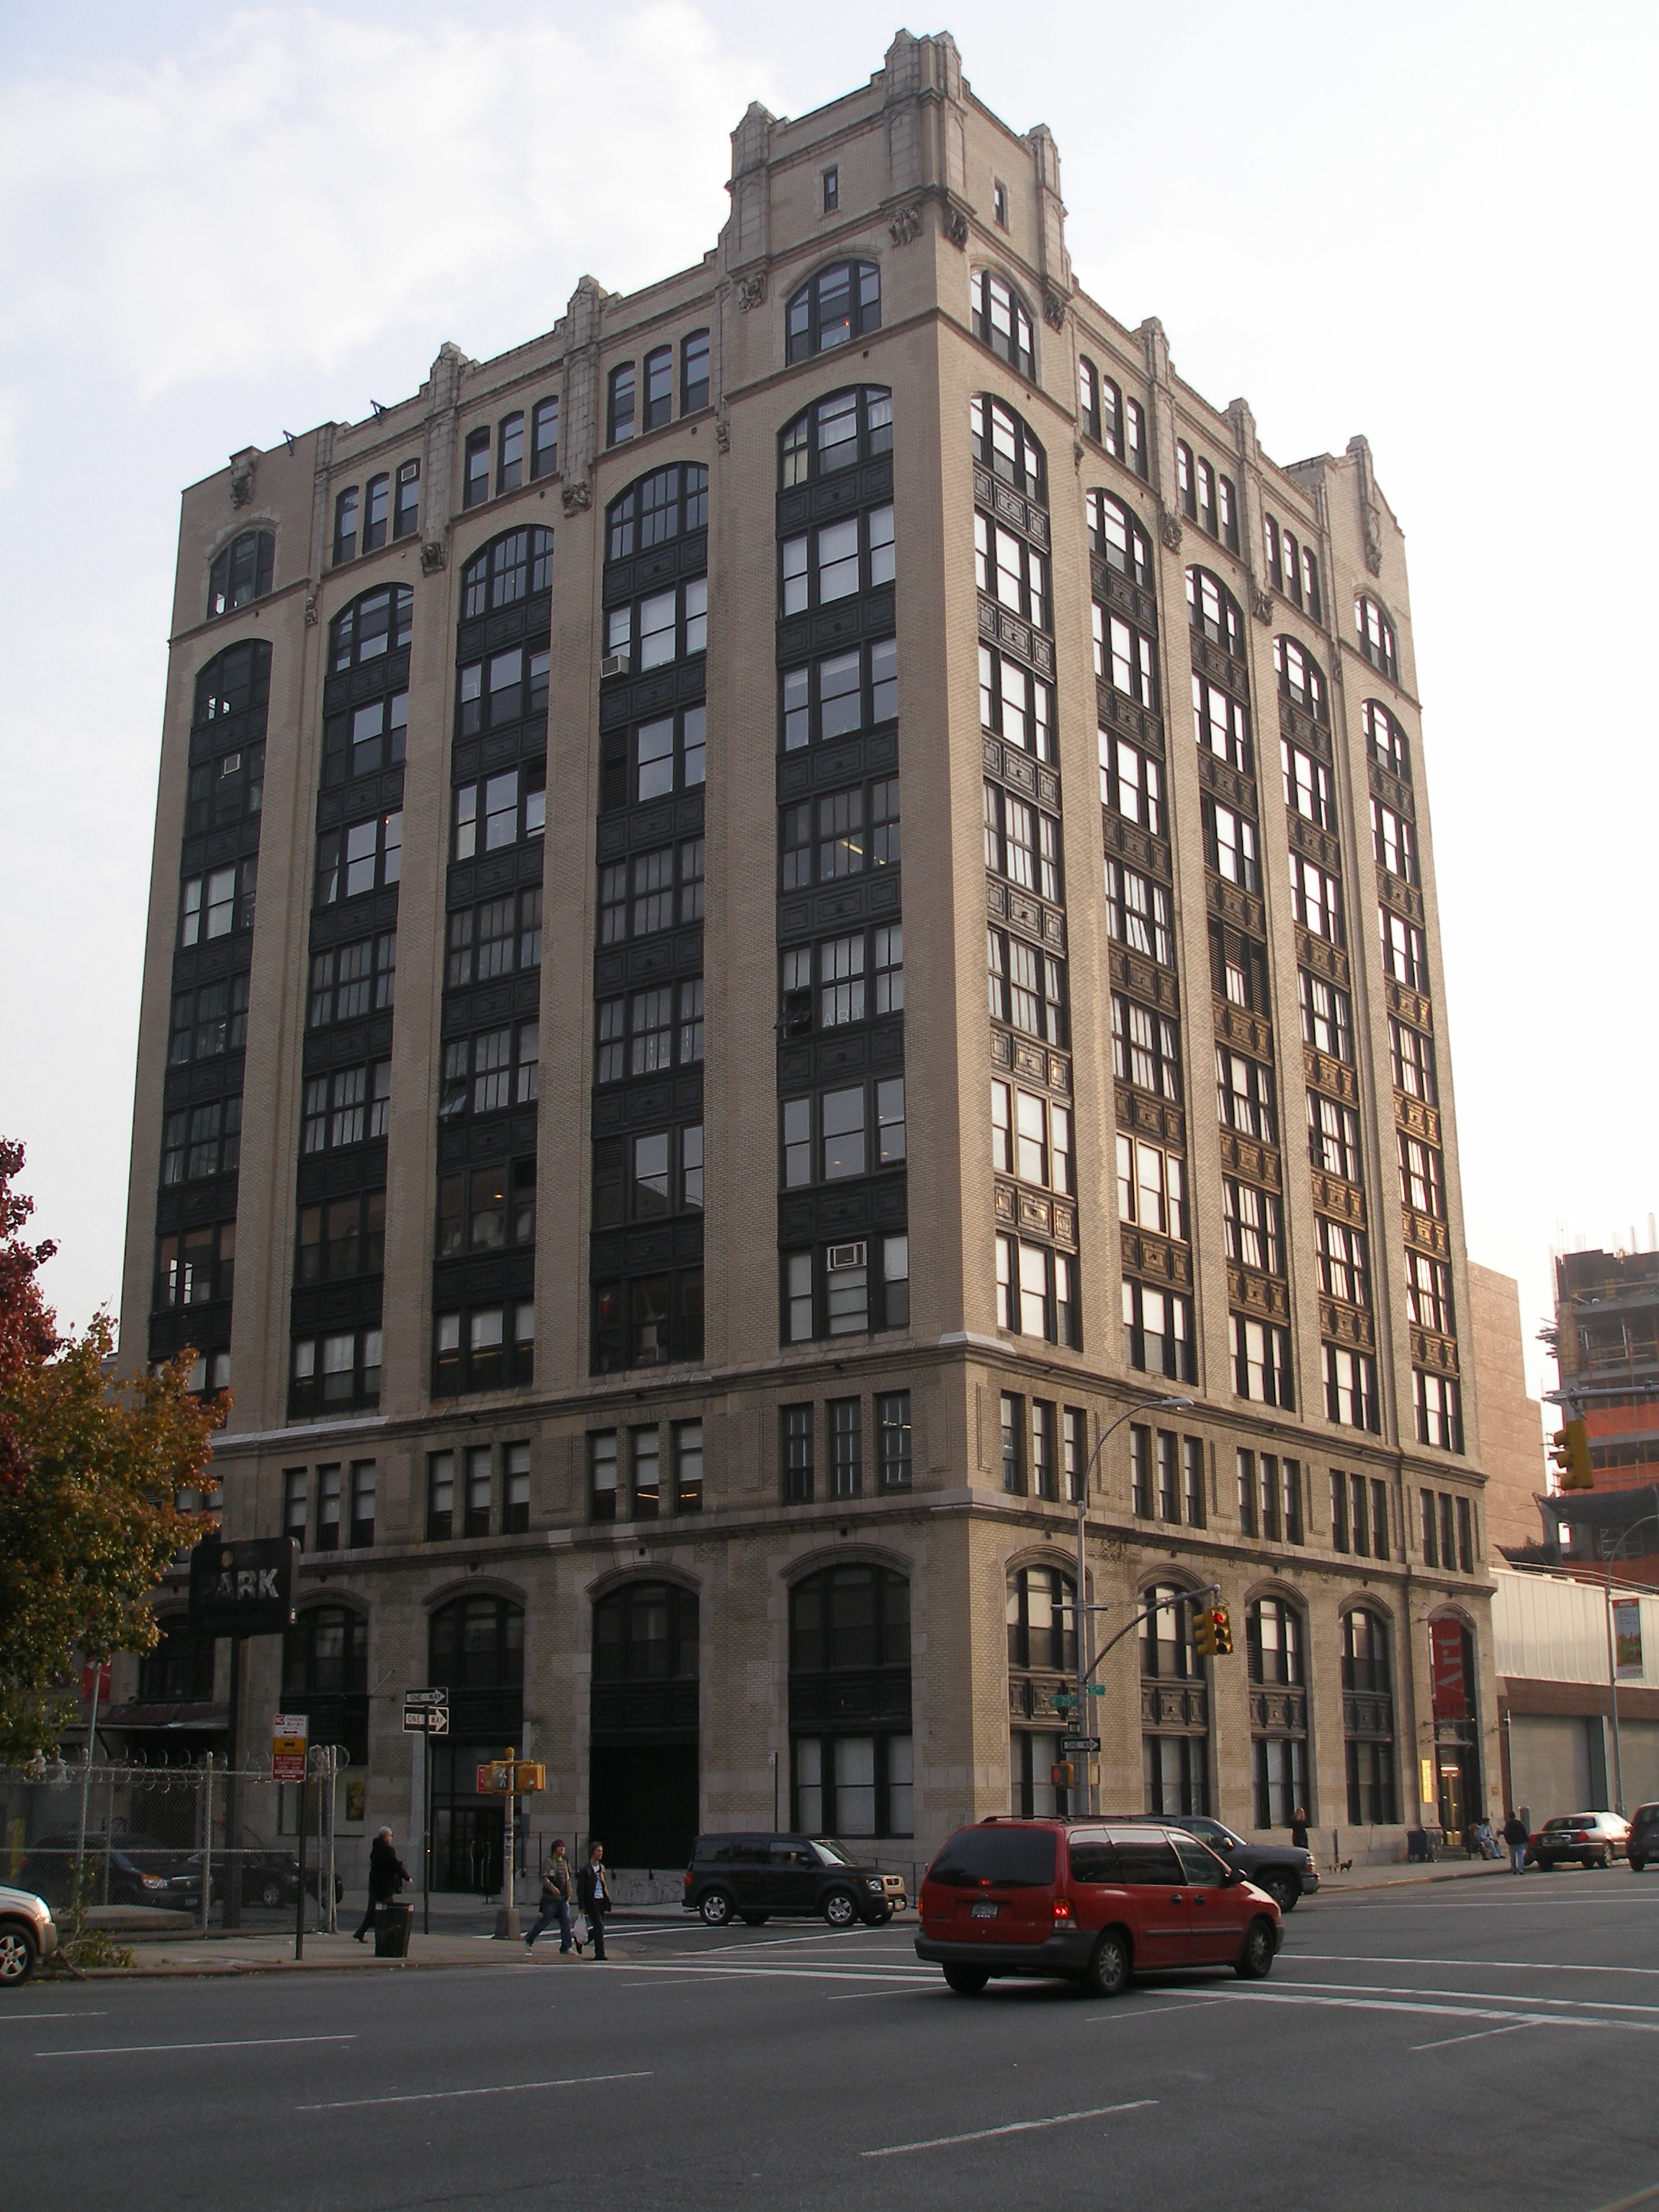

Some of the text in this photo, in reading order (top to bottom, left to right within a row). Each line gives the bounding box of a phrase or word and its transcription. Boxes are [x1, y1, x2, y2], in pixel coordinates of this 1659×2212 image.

[823, 1007, 864, 1028] ART
[1436, 1636, 1463, 1694] Art
[408, 1714, 421, 1723] ONE
